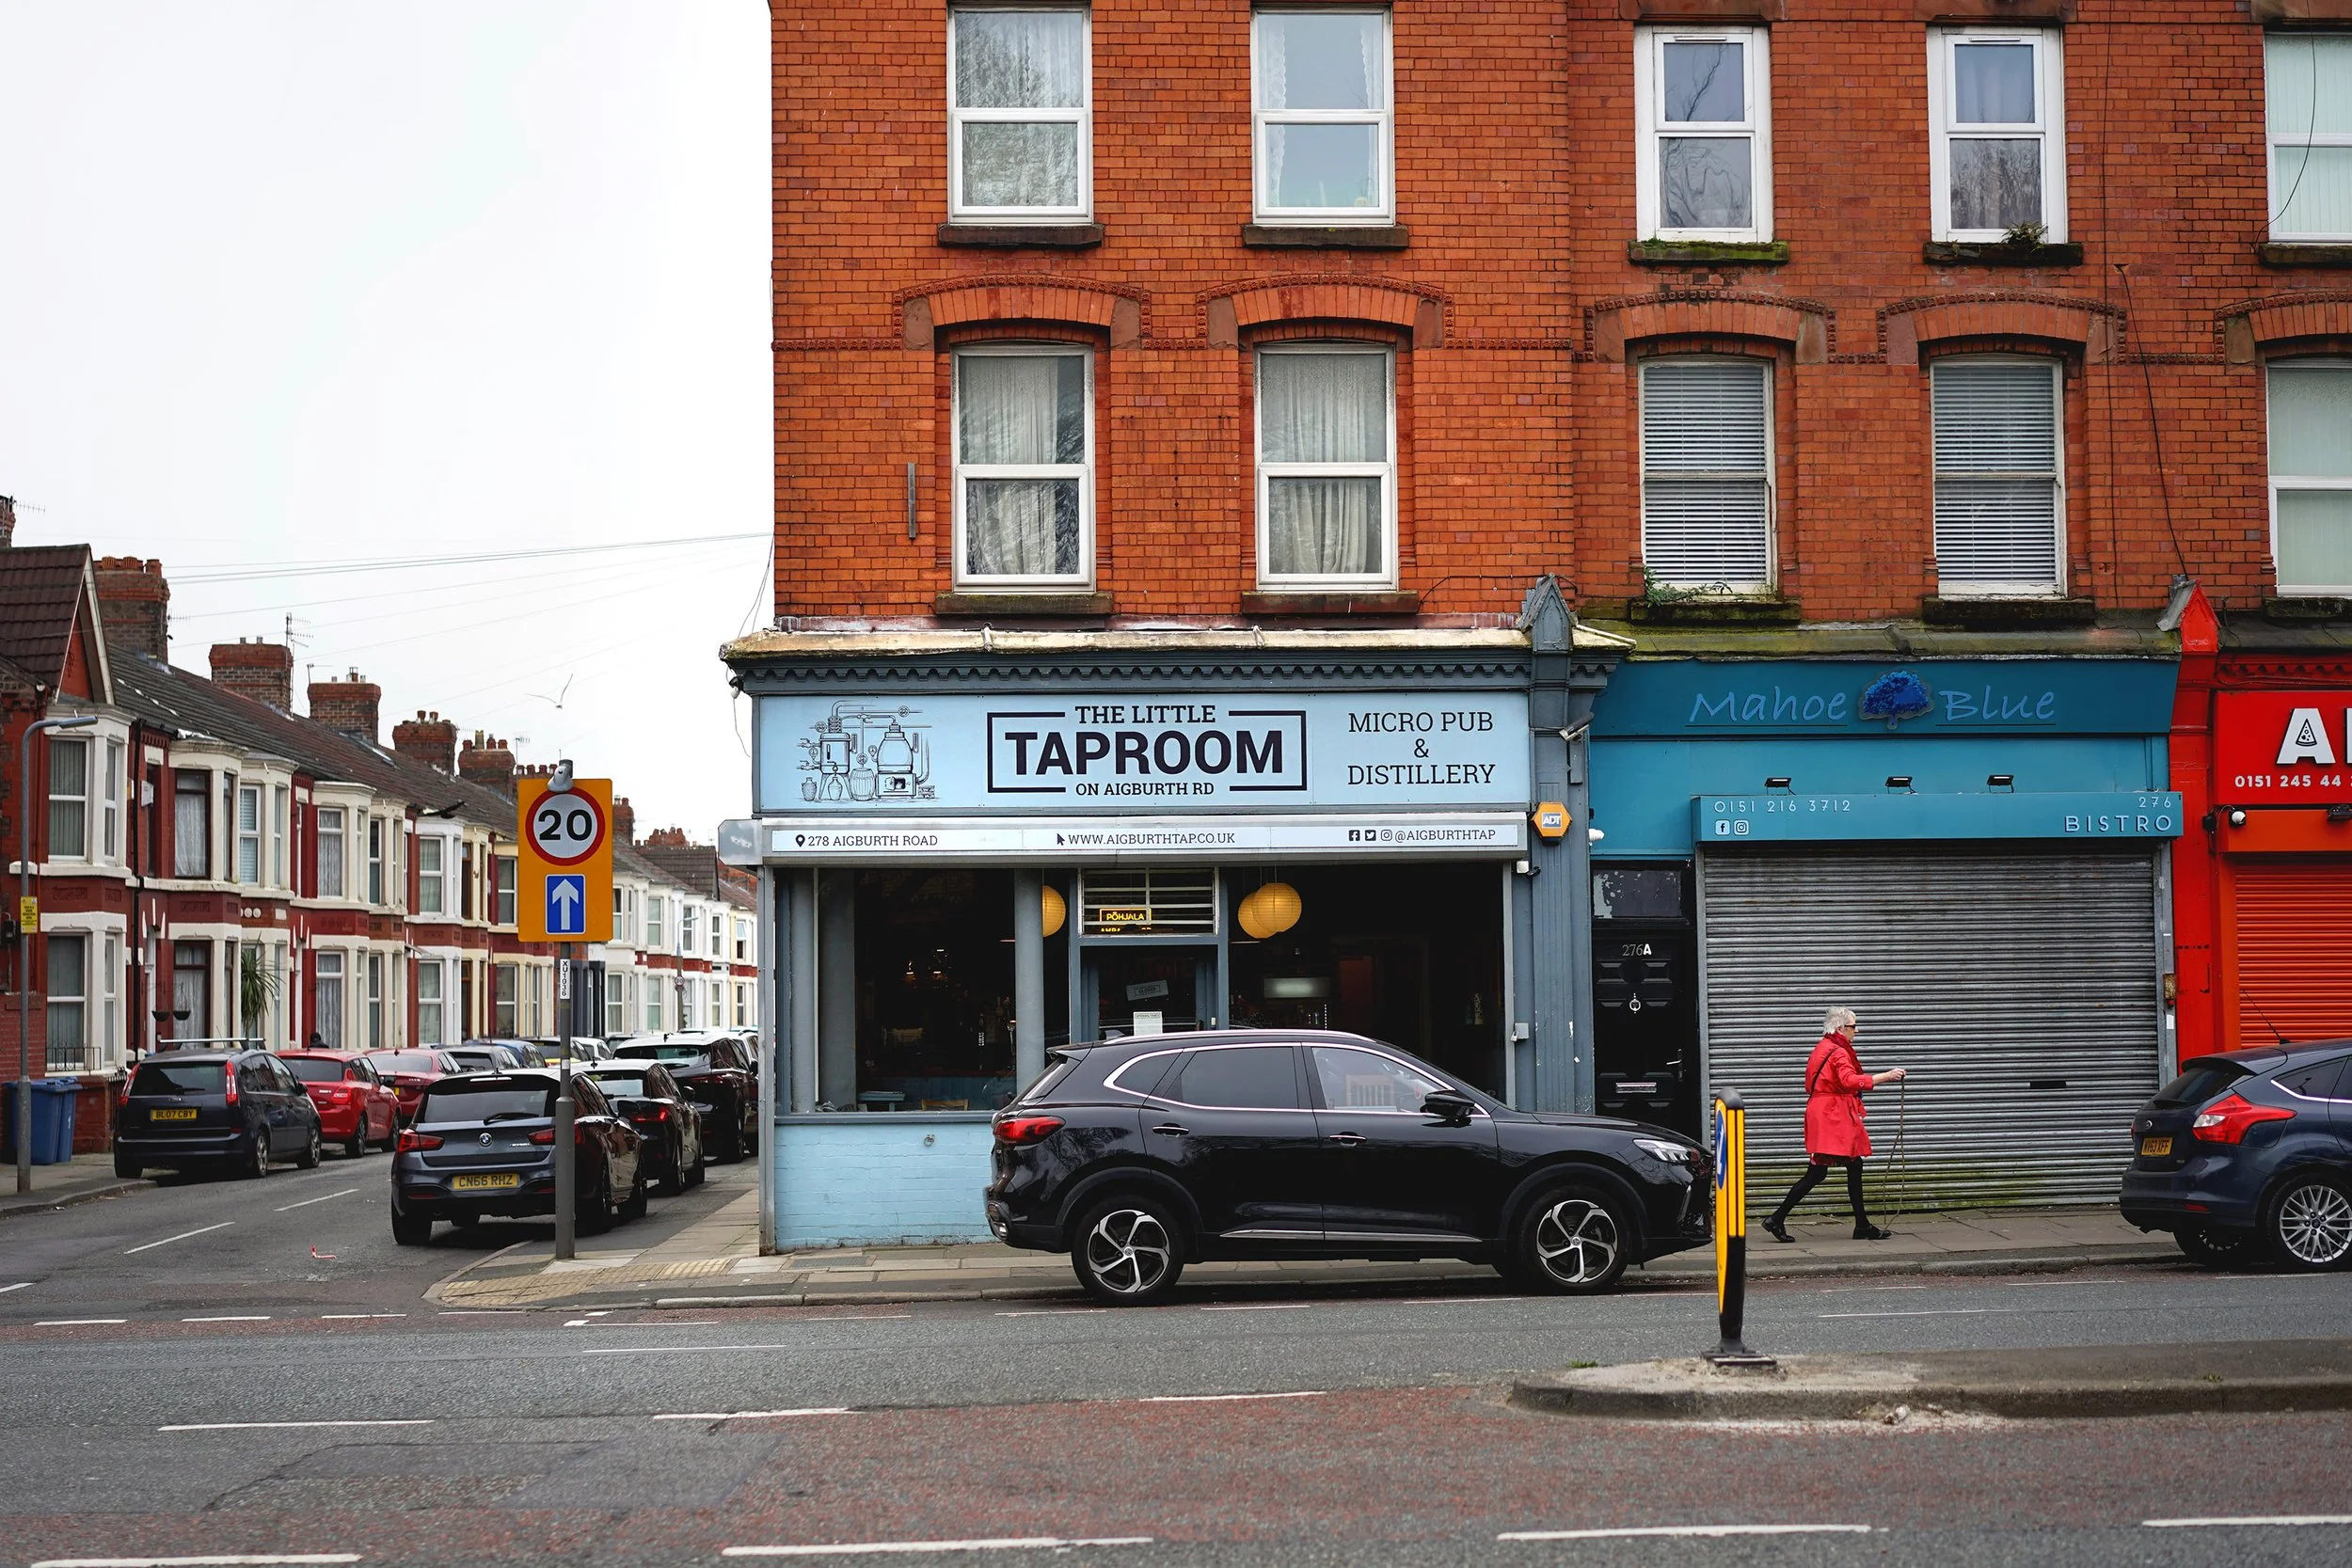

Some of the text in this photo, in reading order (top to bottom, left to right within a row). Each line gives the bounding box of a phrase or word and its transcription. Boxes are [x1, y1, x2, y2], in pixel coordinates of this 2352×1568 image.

[1690, 686, 2055, 722] Mahoe Blue
[1074, 705, 1216, 724] THE LITTLE
[1347, 711, 1494, 733] MICRO PUB
[2276, 708, 2352, 764] A
[1004, 730, 1283, 775] TAPROOM
[1413, 738, 1429, 758] &
[1347, 764, 1496, 785] DISTILLERY
[2234, 775, 2271, 787] 0151
[2280, 775, 2312, 787] 245
[2320, 774, 2342, 787] 44
[1075, 782, 1215, 796] ON AIGBURTH RD
[1714, 799, 1851, 813] 0151 216 3712
[2138, 796, 2171, 809] 276
[538, 809, 593, 841] 20
[1543, 816, 1561, 825] ADT
[2065, 816, 2171, 832] BISTRO
[807, 835, 938, 846] 278 AIGBURTH ROAD
[1068, 833, 1235, 845] WWW.AIGBURTHTAP.CO.UK
[1394, 830, 1496, 843] @AIGBURTHTAP
[1622, 943, 1652, 957] 276A
[458, 1174, 514, 1187] CN66 RHZ
